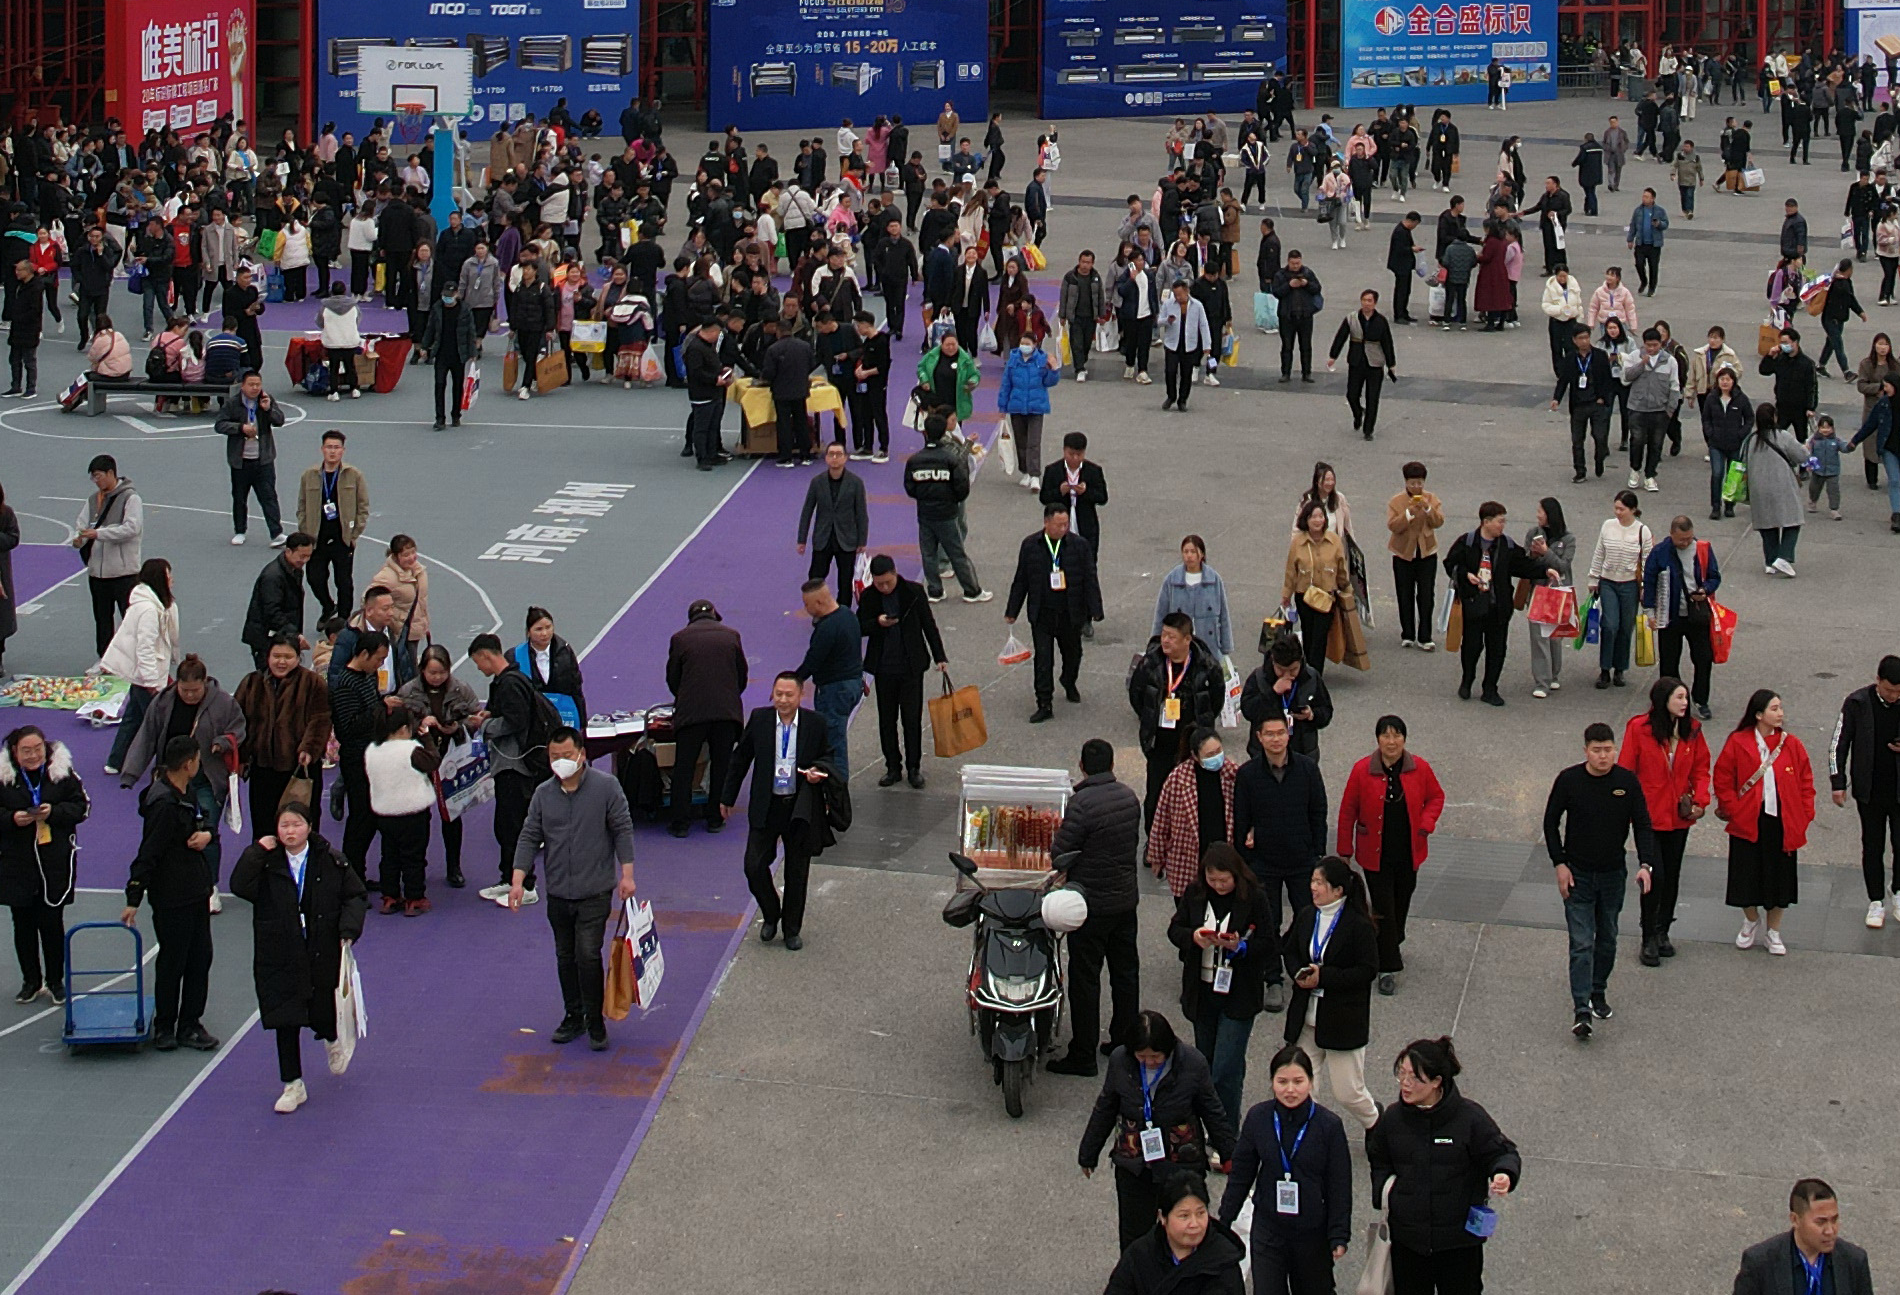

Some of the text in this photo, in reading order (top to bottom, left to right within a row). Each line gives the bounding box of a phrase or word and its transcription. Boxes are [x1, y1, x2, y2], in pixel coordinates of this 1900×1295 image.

[142, 18, 218, 82] 唯美标识
[1407, 3, 1532, 36] 金合盛标识
[477, 481, 637, 565] 河南·郑州
